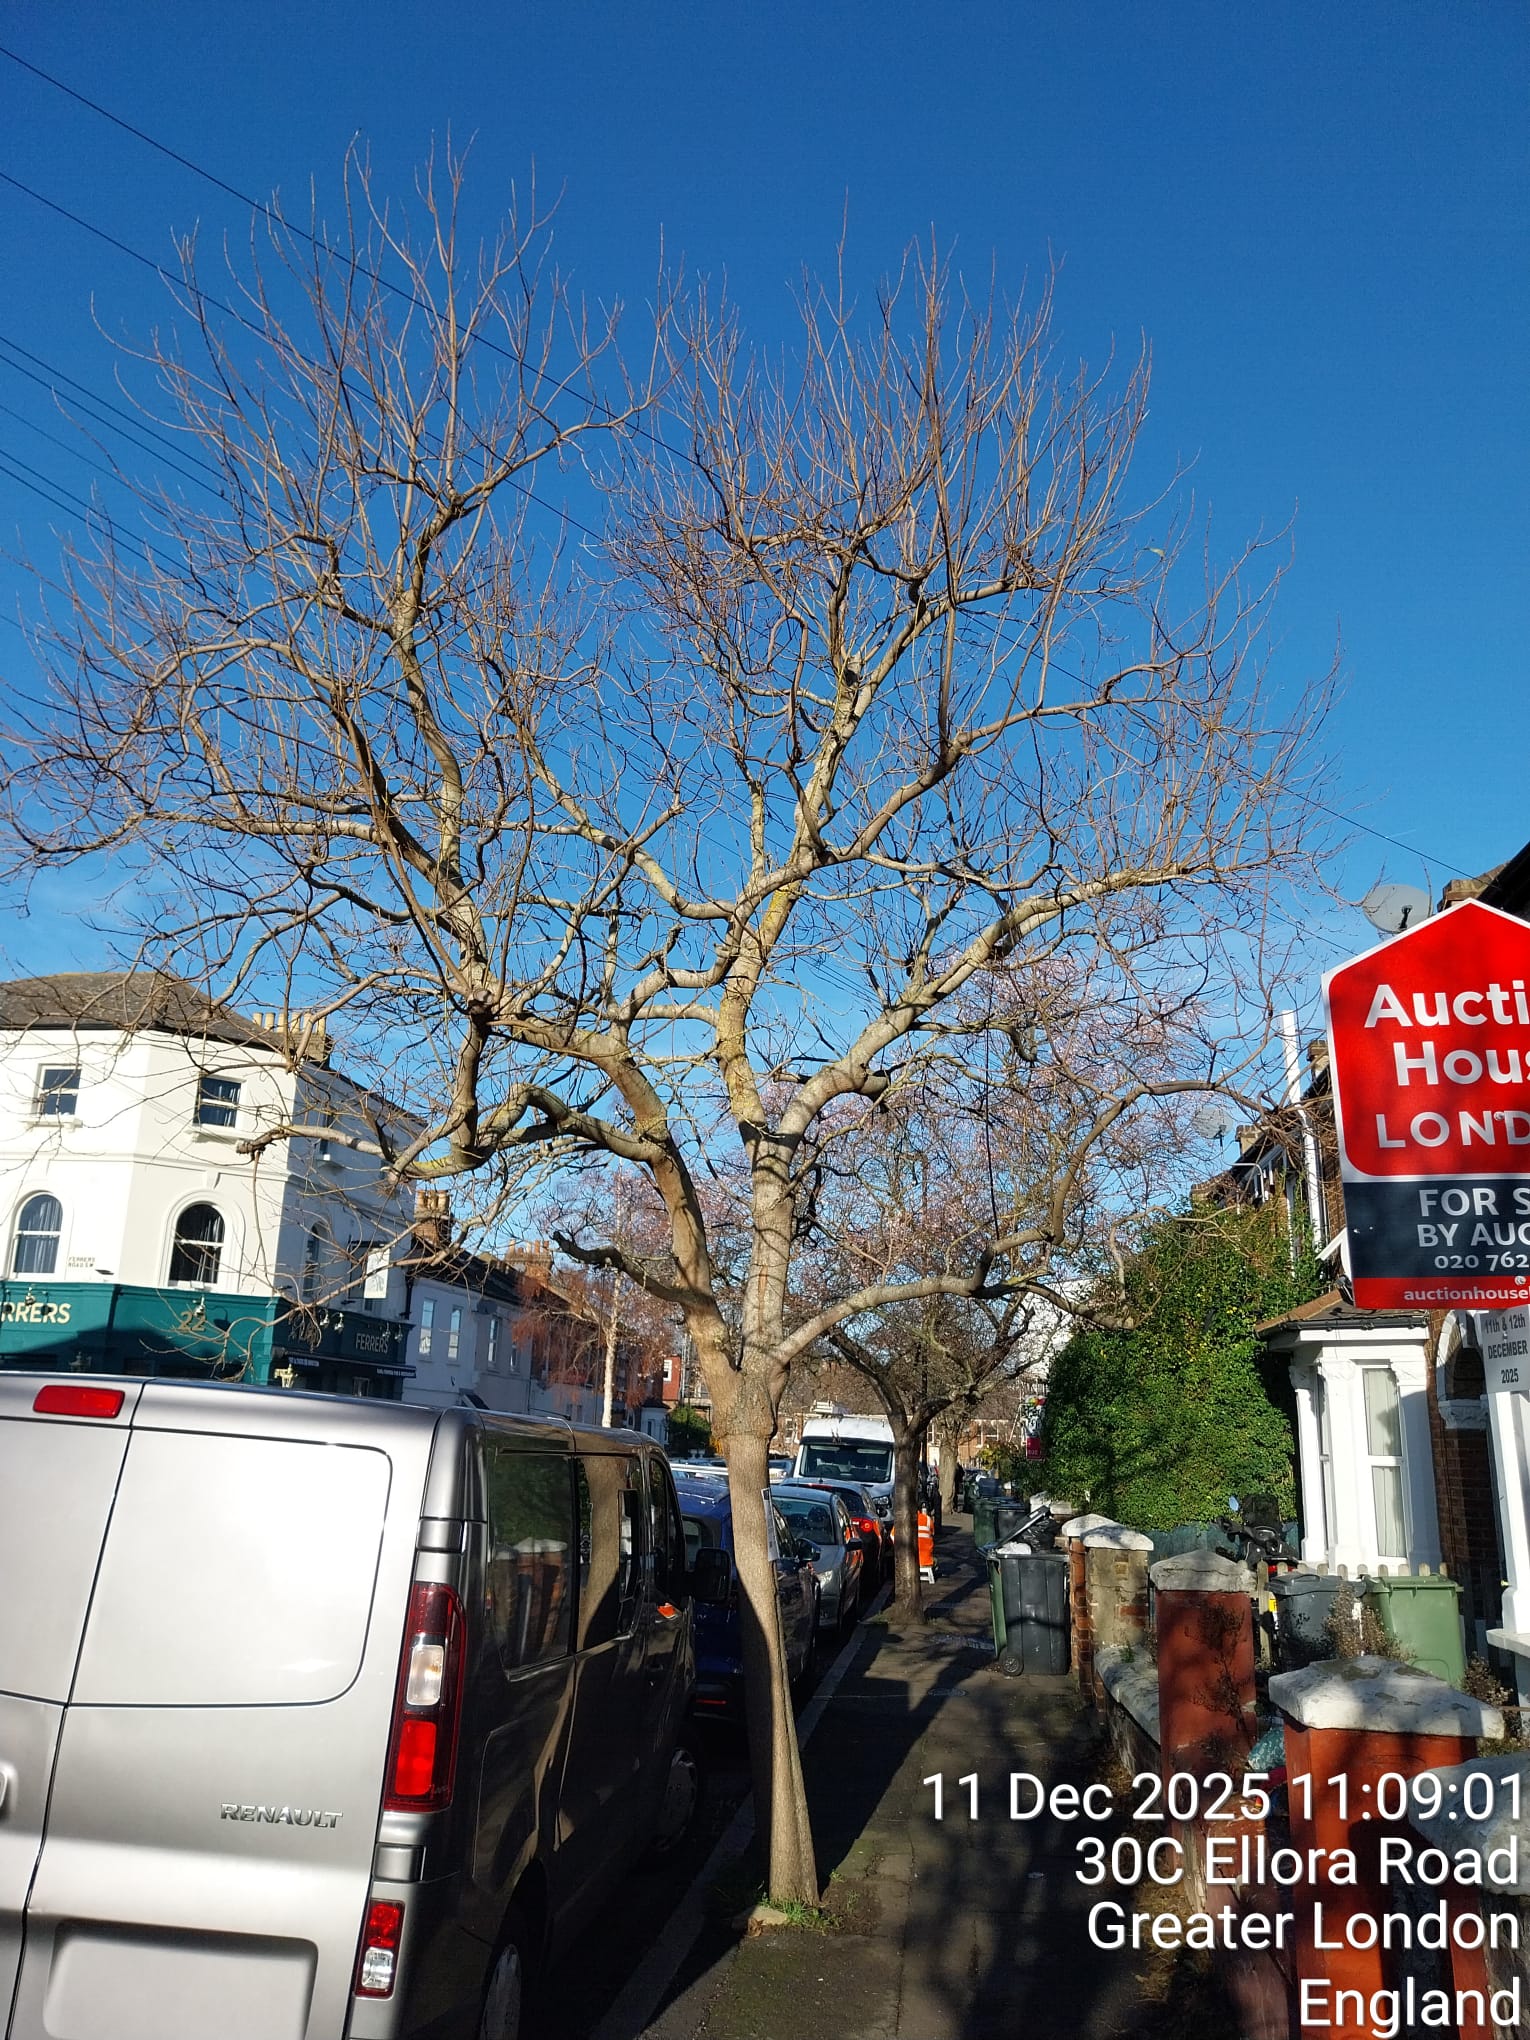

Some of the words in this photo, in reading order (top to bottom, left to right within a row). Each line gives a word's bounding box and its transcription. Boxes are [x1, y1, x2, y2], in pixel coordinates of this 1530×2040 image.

[1364, 980, 1530, 1028] Aucti
[1393, 1040, 1530, 1087] Hou
[1376, 1109, 1530, 1149] LOND
[1418, 1188, 1500, 1217] FOR
[1417, 1223, 1459, 1248] BY
[1434, 1254, 1480, 1269] 020
[1485, 1250, 1530, 1272] 762
[1403, 1286, 1530, 1302] auctionhouse
[0, 1301, 72, 1325] RRERS
[177, 1311, 206, 1332] 22
[1484, 1318, 1501, 1335] 11th
[1502, 1316, 1508, 1332] &
[1509, 1313, 1526, 1329] 12th
[355, 1332, 390, 1355] FERRERS
[1487, 1340, 1529, 1360] DECEMBER
[1500, 1367, 1519, 1384] 2025
[219, 1803, 344, 1829] RENAULT
